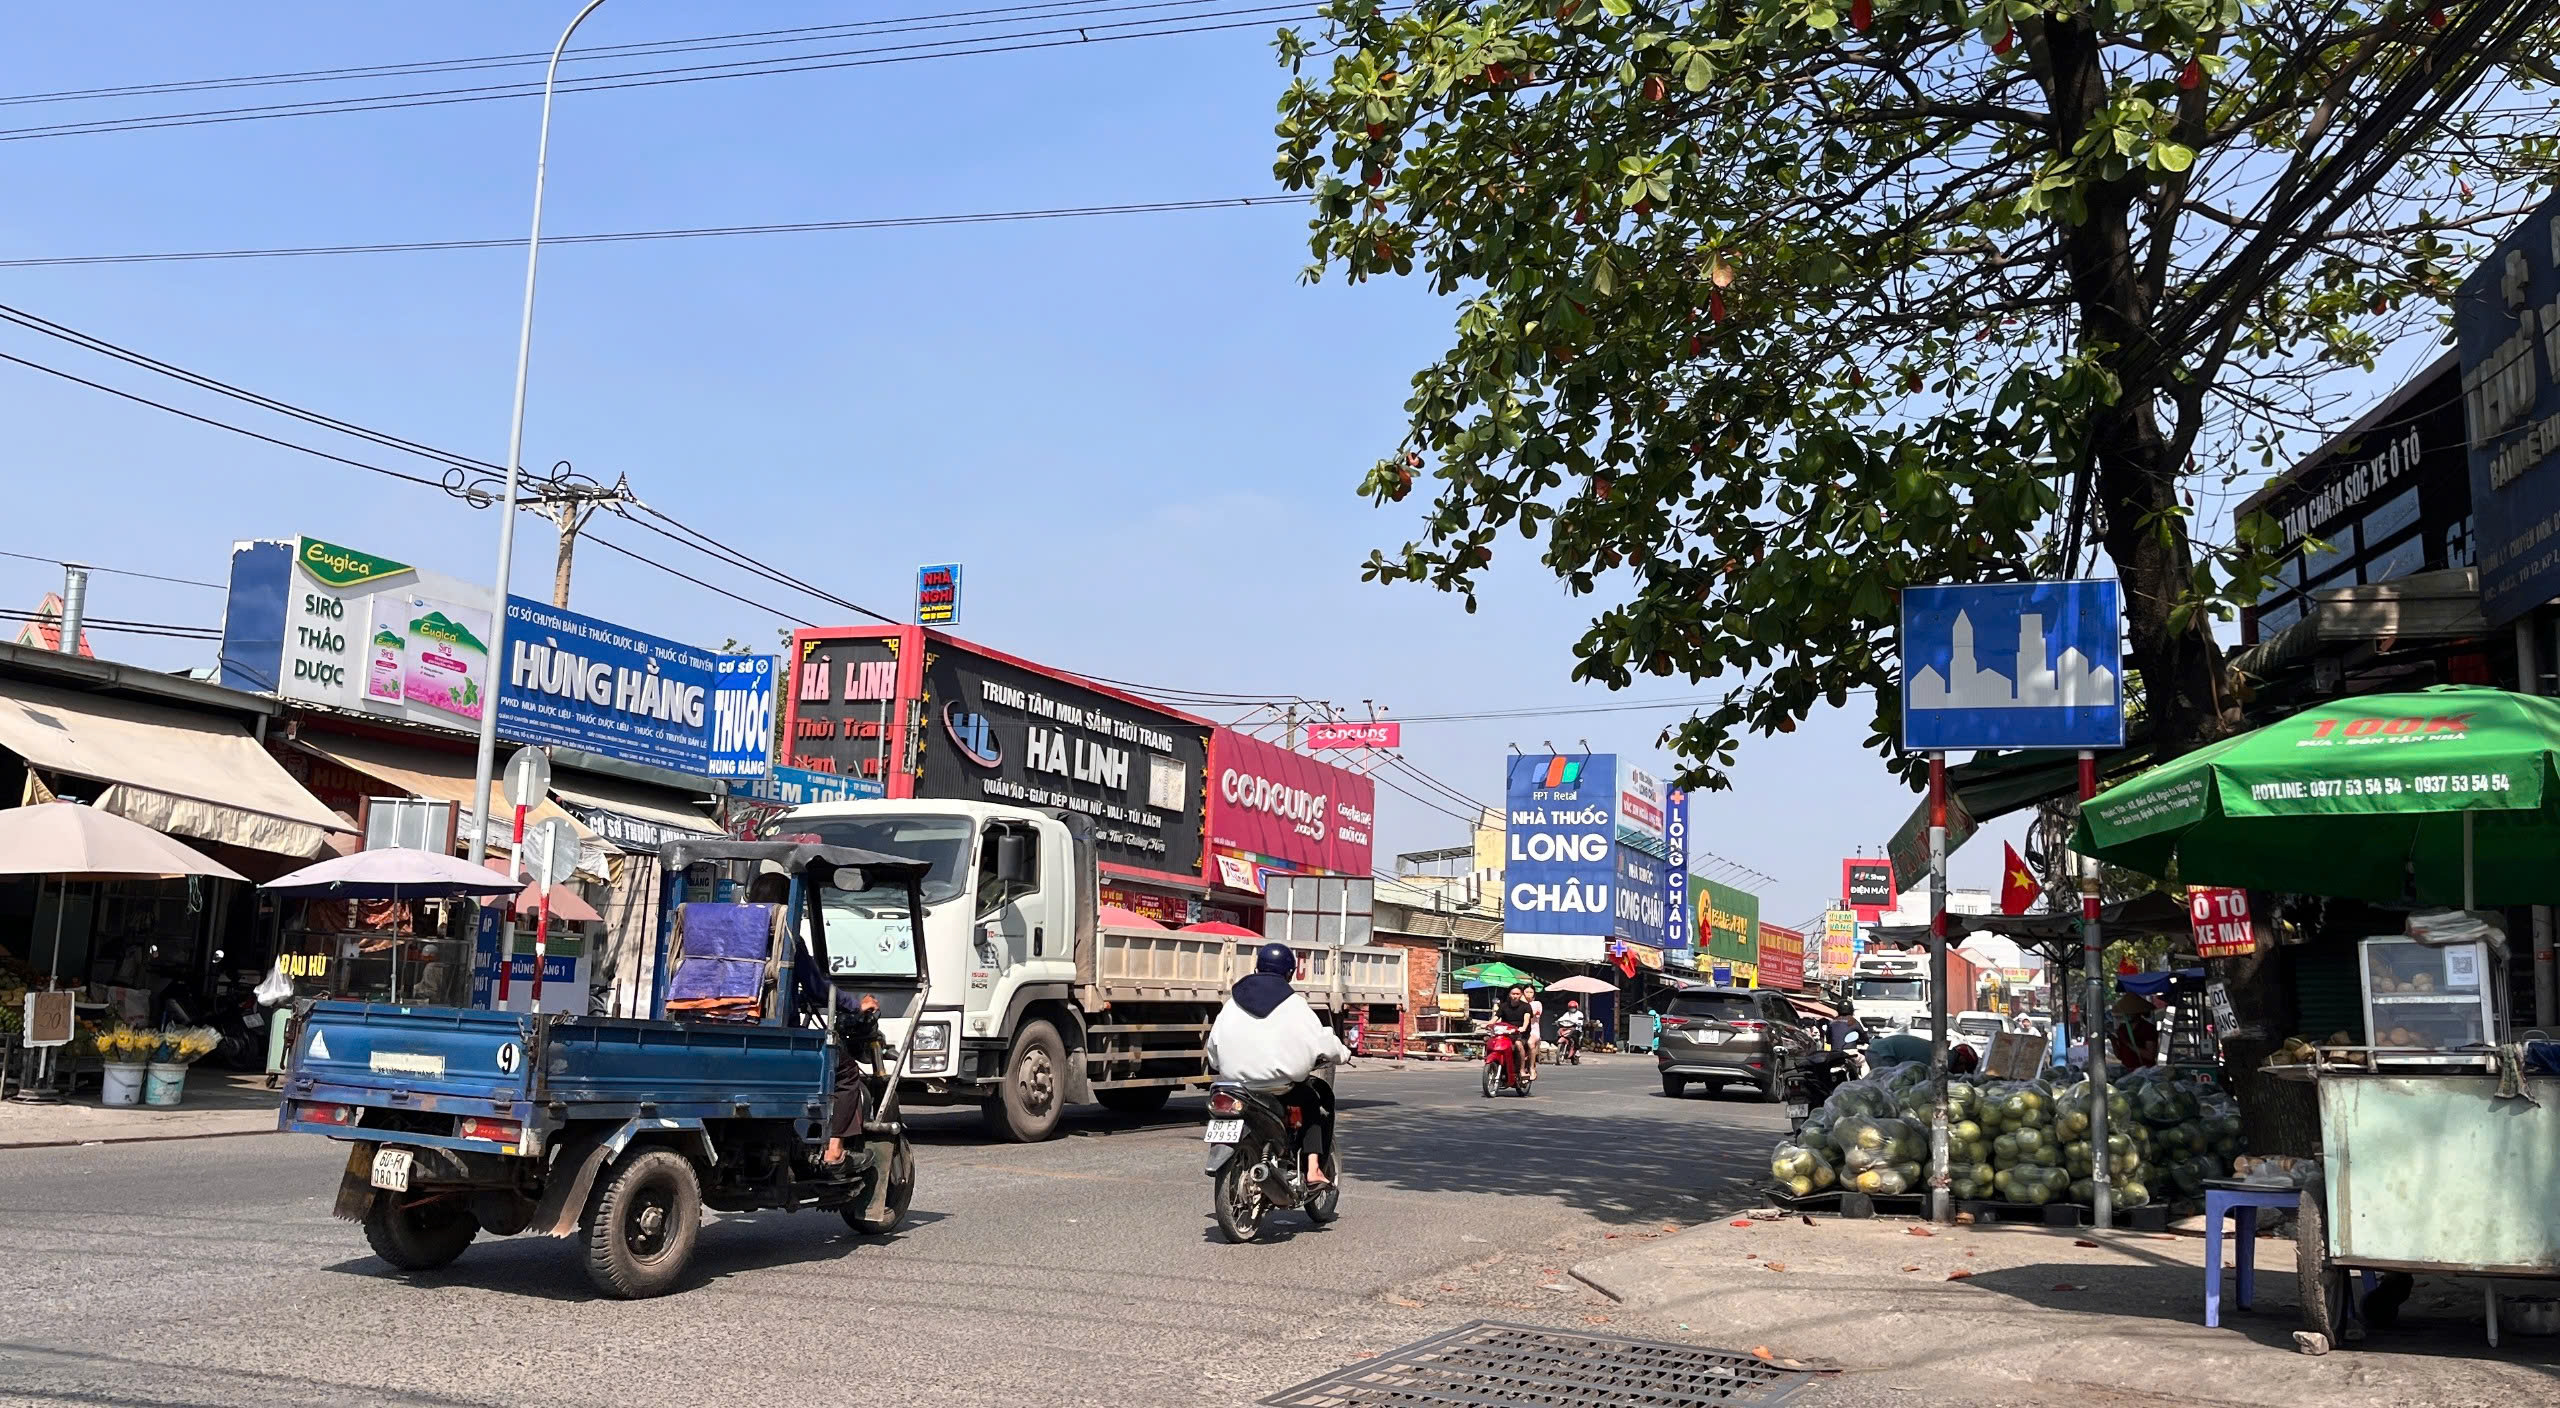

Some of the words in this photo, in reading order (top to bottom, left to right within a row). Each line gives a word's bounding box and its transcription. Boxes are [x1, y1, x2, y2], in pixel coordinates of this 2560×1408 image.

[2345, 464, 2370, 506] SÓC
[2371, 451, 2388, 492] XE
[2390, 438, 2399, 478] Ô
[2402, 425, 2421, 471] TÔ
[306, 544, 370, 576] Eugica
[305, 592, 343, 619] SIRÔ
[421, 623, 457, 642] Eugica
[507, 604, 519, 618] CƠ
[520, 607, 532, 621] SỞ
[532, 611, 561, 631] CHUYÊN
[562, 619, 577, 635] BÁN
[578, 622, 587, 637] LẺ
[589, 624, 613, 645] THUỐC
[613, 633, 632, 650] DƯỢC
[633, 640, 649, 655] LIỆU
[655, 646, 677, 662] THUỐC
[295, 658, 344, 688] DƯỢC
[718, 661, 736, 674] CƠ
[737, 658, 754, 674] SỞ
[801, 654, 830, 700] HÀ
[844, 662, 897, 700] LINH
[512, 637, 612, 707] HÙNG
[616, 656, 705, 728] HẰNG
[521, 701, 537, 712] MUA
[538, 704, 557, 717] DƯỢC
[558, 708, 571, 719] LIỆU
[575, 712, 597, 725] THUỐC
[598, 718, 615, 729] DƯỢC
[616, 722, 630, 732] LIỆU
[634, 725, 653, 738] THUỐC
[714, 676, 770, 752] THUỐC
[982, 681, 1024, 710] TRUNG
[1028, 693, 1054, 717] TÂM
[1057, 703, 1082, 726] MUA
[1085, 708, 1111, 735] SẮM
[1114, 720, 1138, 742] THỜI
[1139, 728, 1173, 752] TRANG
[2313, 713, 2477, 738] 100K
[953, 713, 997, 760] HL
[1317, 728, 1388, 741] concung
[709, 757, 735, 774] HÙNG
[737, 755, 765, 775] HẰNG
[1027, 726, 1068, 776] HÀ
[1074, 738, 1129, 790] LINH
[751, 774, 803, 804] HẺM
[1533, 791, 1548, 800] FPT
[2251, 782, 2307, 800] HOTLINE:
[2310, 780, 2342, 797] 0977
[2345, 780, 2362, 796] 53
[2365, 779, 2382, 795] 54
[2385, 778, 2402, 794] 54
[2414, 776, 2448, 793] 0937
[2451, 776, 2468, 792] 53
[2471, 775, 2489, 791] 54
[2491, 774, 2509, 791] 54
[983, 778, 1010, 796] QUẦN
[1011, 785, 1024, 799] ÁO
[1030, 787, 1049, 805] GIÀY
[1051, 791, 1067, 807] DÉP
[1069, 795, 1089, 812] NAM
[1090, 800, 1102, 815] NỮ
[1107, 805, 1123, 820] VALI
[1128, 807, 1140, 824] TÚI
[1142, 810, 1161, 828] XÁCH
[1221, 768, 1327, 840] concung
[1512, 807, 1547, 824] NHÀ
[1551, 804, 1608, 824] THUỐC
[590, 815, 605, 836] CƠ
[607, 818, 622, 838] SỞ
[1669, 808, 1684, 866] LONG
[1511, 833, 1608, 861] LONG
[1628, 861, 1639, 879] NHÀ
[1639, 864, 1653, 885] THUỐC
[1870, 873, 1886, 881] Shop
[1511, 877, 1608, 912] CHÂU
[1851, 885, 1870, 895] ĐIỆN
[1871, 886, 1889, 894] MÁY
[1616, 888, 1639, 922] LONG
[1641, 893, 1664, 928] CHÂU
[1669, 873, 1684, 939] CHÂU
[2193, 893, 2210, 920] Ô
[2215, 890, 2246, 918] TÔ
[482, 915, 492, 932] ÁP
[2196, 925, 2216, 944] XE
[2218, 918, 2251, 943] MÁY
[280, 951, 307, 979] ĐẬU
[308, 952, 327, 976] HŨ
[476, 953, 491, 967] MÁY
[512, 959, 534, 974] HÙNG
[543, 959, 559, 975] ẰNG
[562, 966, 566, 976] 1
[475, 973, 488, 991] HÚT
[502, 1043, 513, 1075] 9
